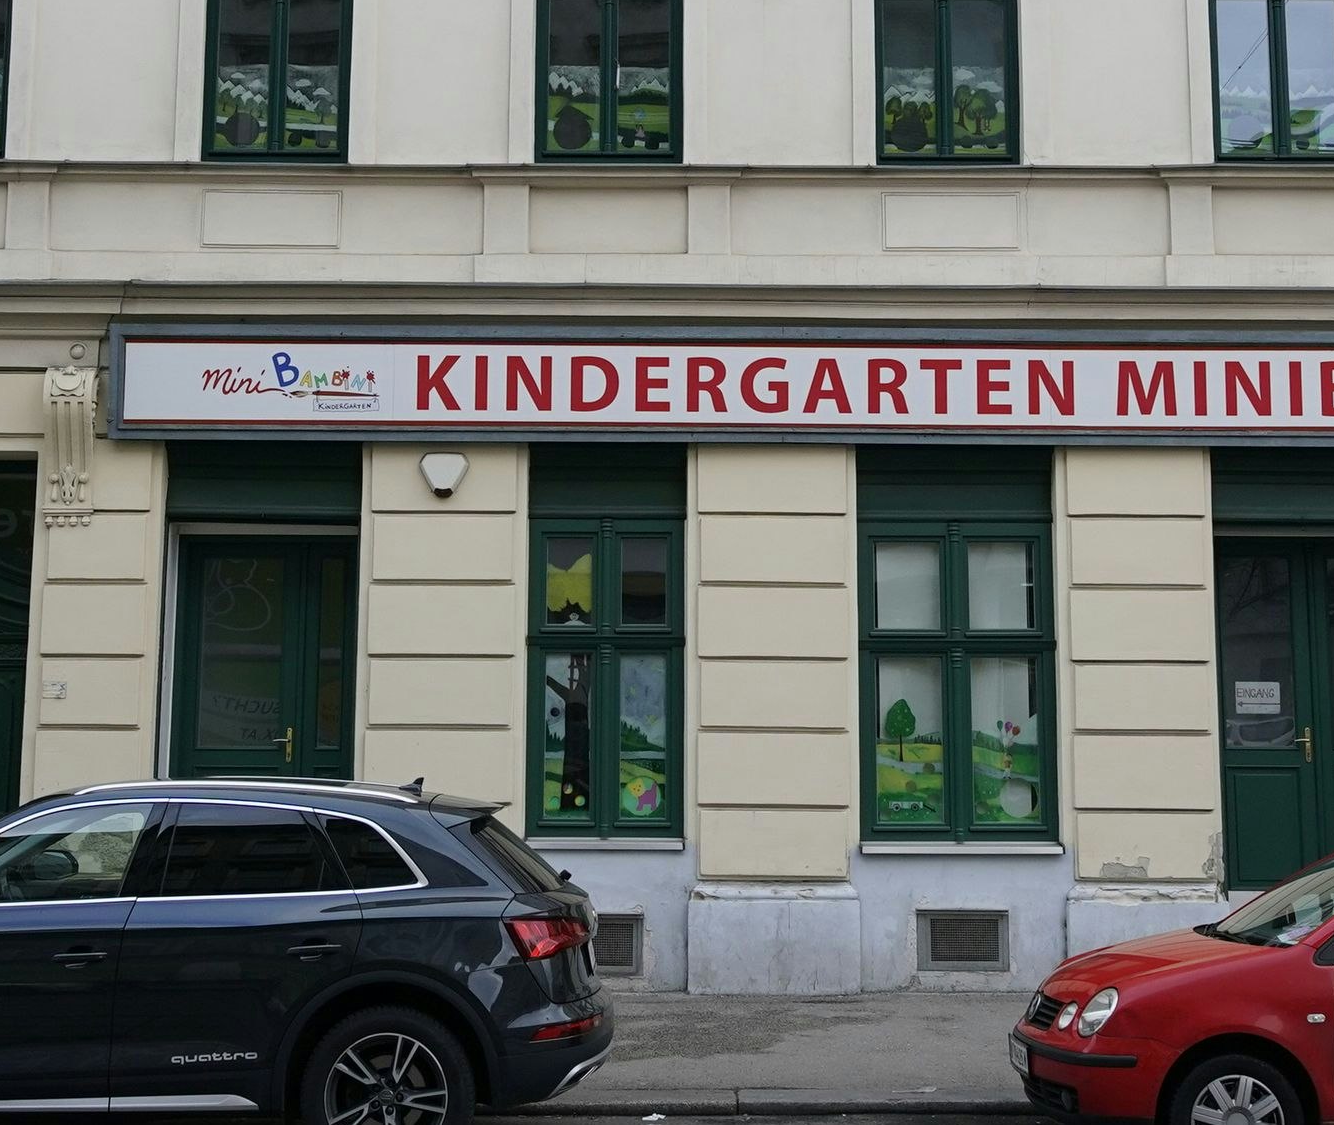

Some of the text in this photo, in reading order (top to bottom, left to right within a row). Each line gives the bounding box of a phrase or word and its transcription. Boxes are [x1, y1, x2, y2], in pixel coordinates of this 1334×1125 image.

[417, 355, 1075, 416] KINDERGARTEN
[1236, 687, 1275, 699] EINGANG
[171, 1049, 258, 1065] quattro
